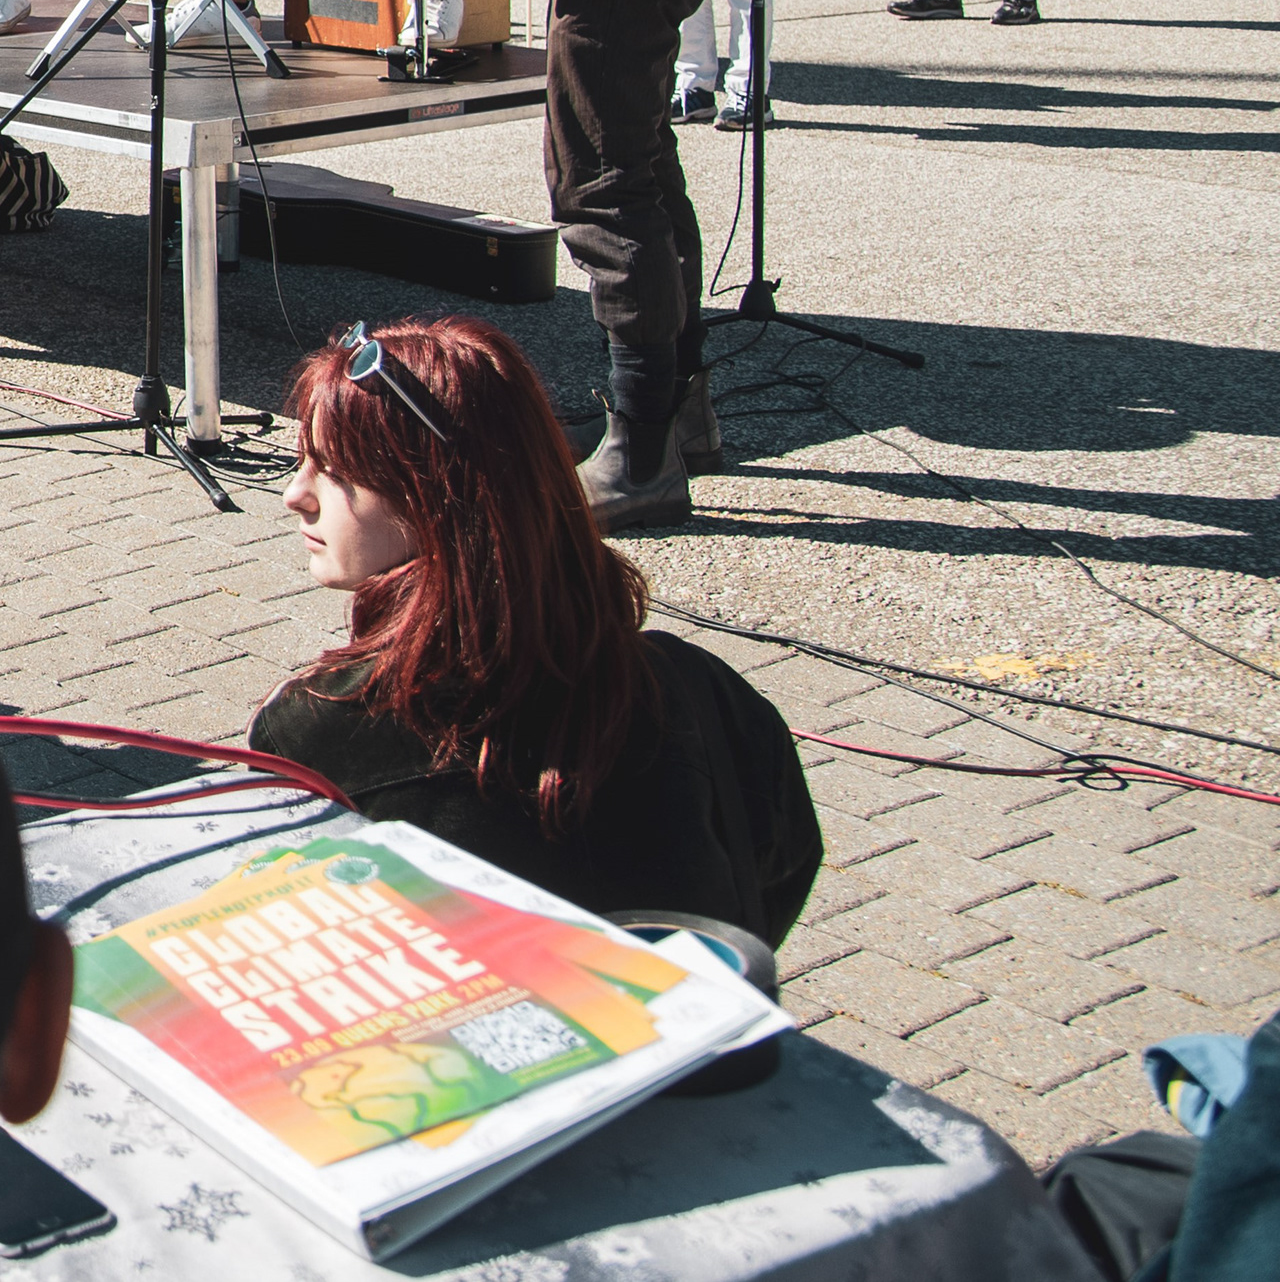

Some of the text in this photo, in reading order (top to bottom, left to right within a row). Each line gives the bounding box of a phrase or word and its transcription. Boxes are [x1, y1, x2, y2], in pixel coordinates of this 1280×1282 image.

[150, 882, 393, 977] GLOBAL
[187, 906, 432, 1009] CLIMATE
[220, 932, 487, 1052] STRIKE
[271, 1038, 333, 1068] 23.09
[402, 989, 460, 1019] PARK
[456, 972, 505, 1000] 2PM
